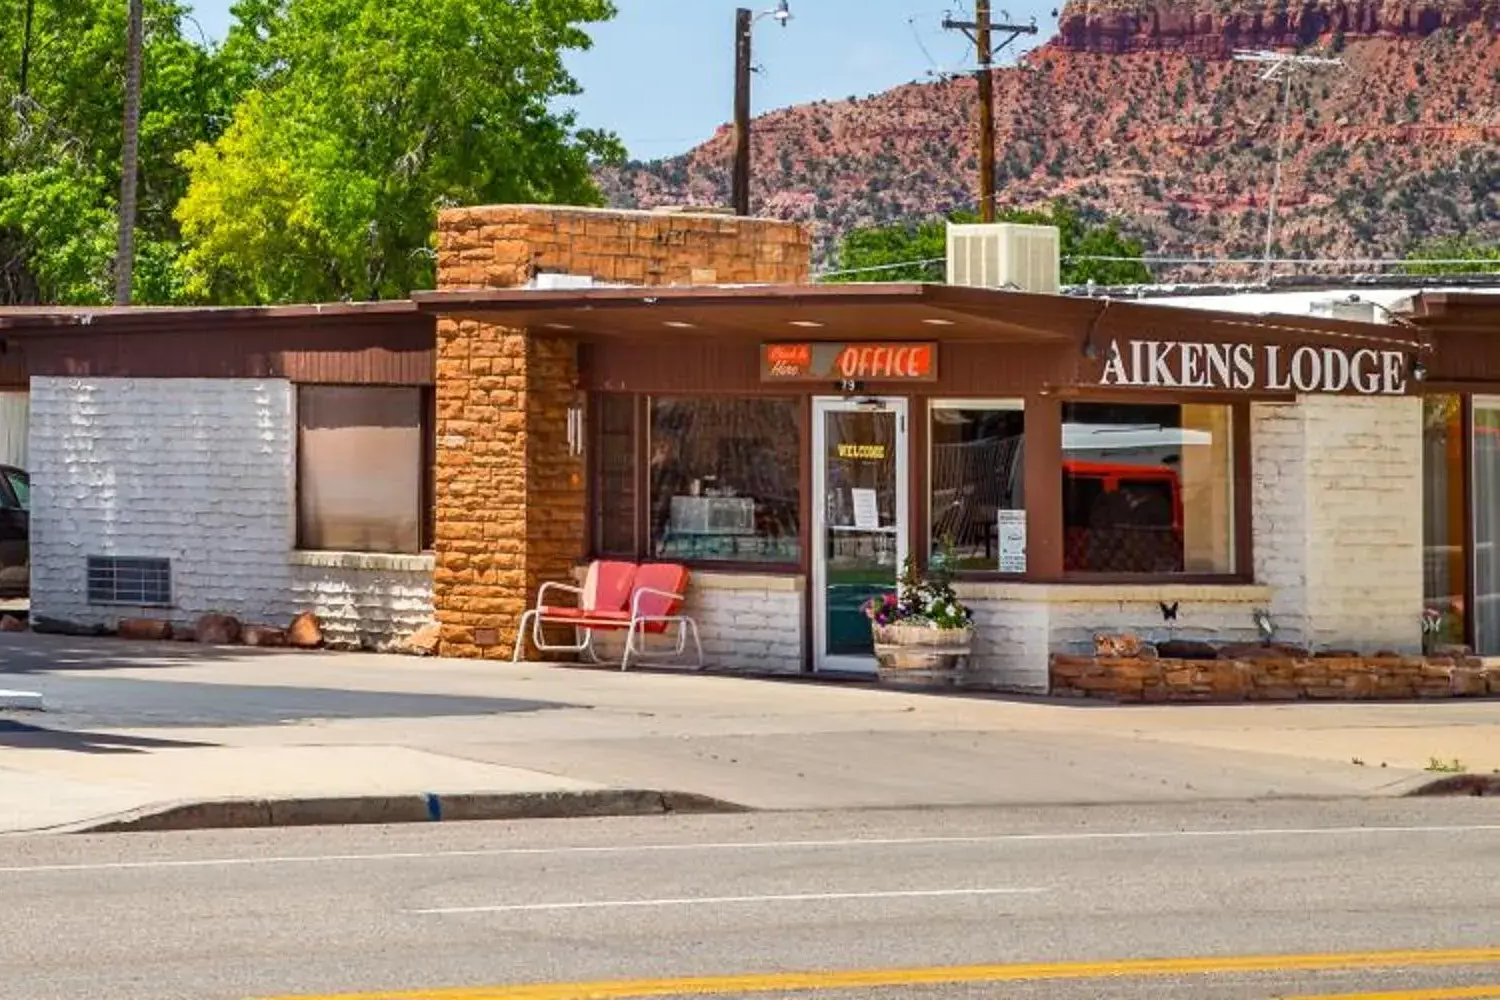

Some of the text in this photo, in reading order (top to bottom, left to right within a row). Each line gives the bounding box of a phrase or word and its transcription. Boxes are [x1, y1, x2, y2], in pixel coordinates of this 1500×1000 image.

[841, 347, 920, 377] OFFICE
[1101, 338, 1406, 394] AIKENS LODGE
[837, 443, 885, 459] WELCOME
